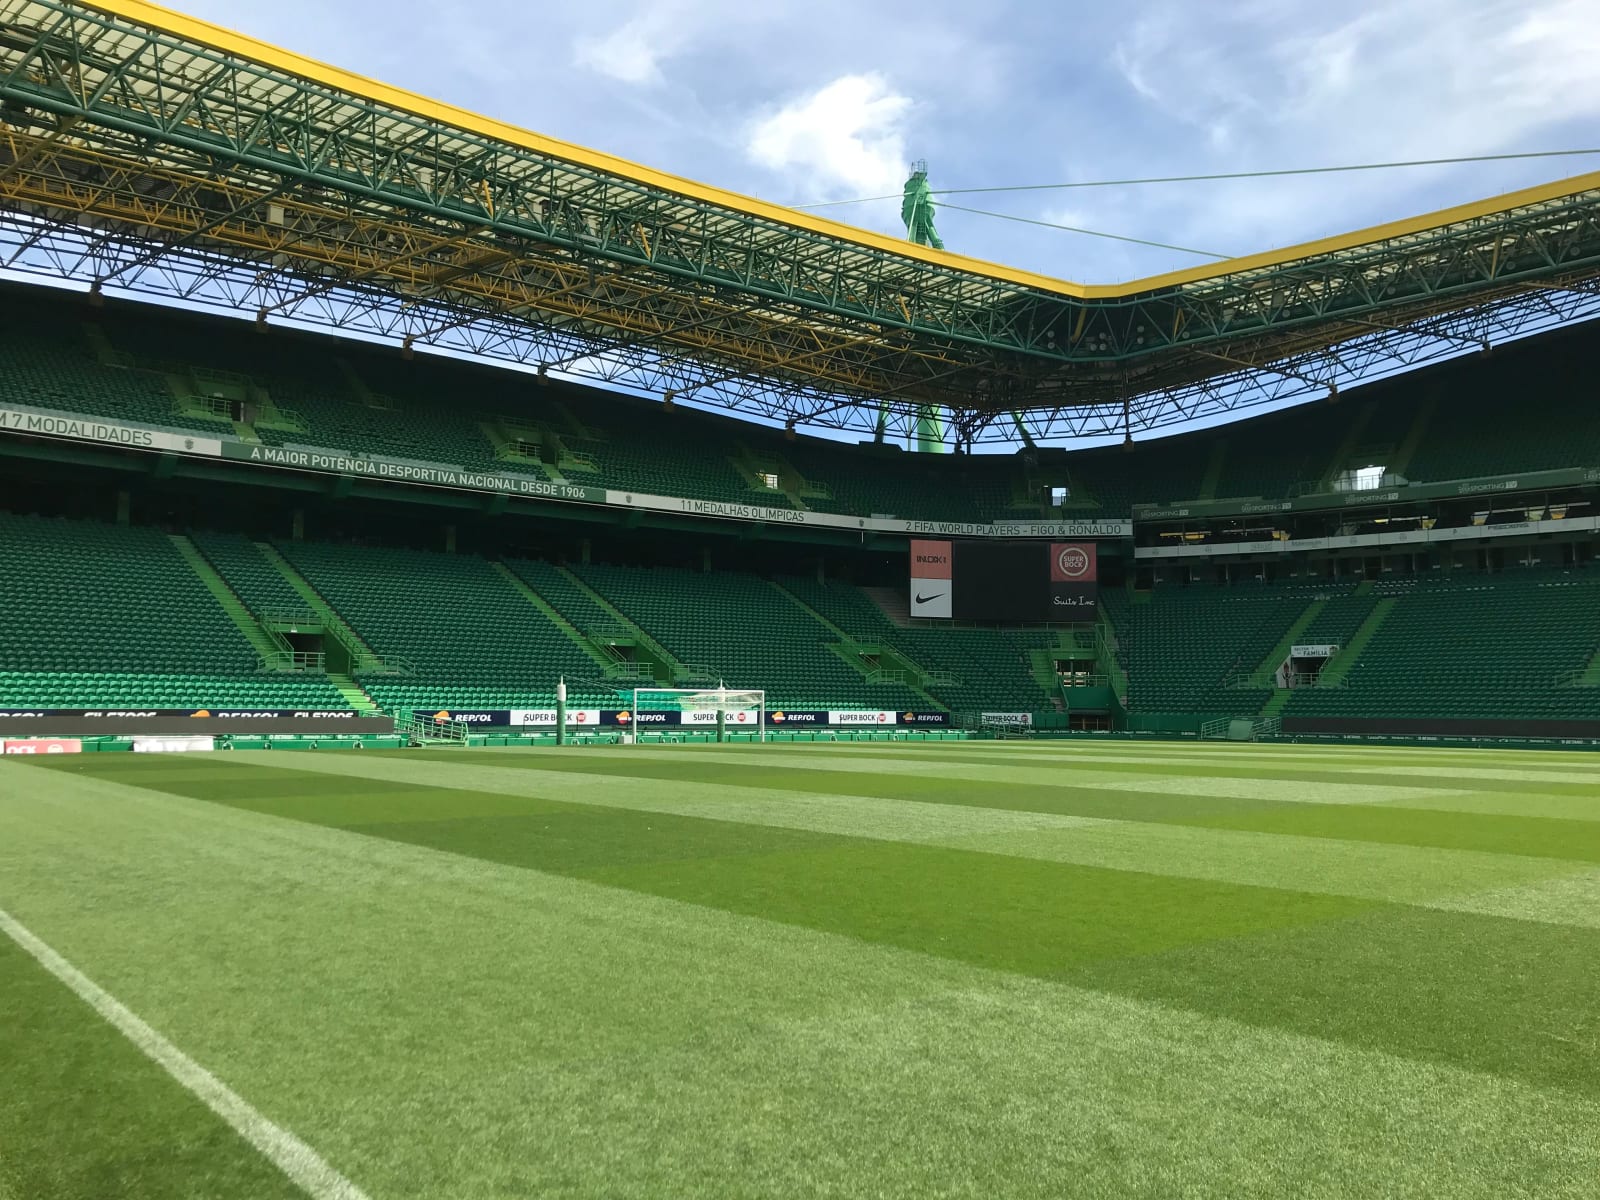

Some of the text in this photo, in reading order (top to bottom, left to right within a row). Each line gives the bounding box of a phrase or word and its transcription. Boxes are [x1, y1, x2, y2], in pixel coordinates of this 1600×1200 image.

[13, 414, 22, 427] 7
[27, 416, 152, 446] MODALIDADES
[250, 448, 585, 499] A MAIOR POTÊNCIA DESPORTIVA NACIONAL DESDE 1906
[681, 500, 804, 522] 11 MEDALHAS OLÍMPICAS
[906, 522, 912, 530] 2
[915, 522, 934, 532] FIFA
[939, 523, 974, 534] WORLD
[977, 524, 1020, 535] PLAYERS
[1031, 525, 1055, 535] FIGO
[1058, 525, 1065, 535] &
[1069, 524, 1121, 535] RONALDO
[455, 714, 492, 722] REPSOL
[524, 713, 550, 722] SUPER
[693, 713, 715, 721] SUPER
[839, 713, 876, 721] SUPER BOCK
[918, 714, 943, 722] REPSOL
